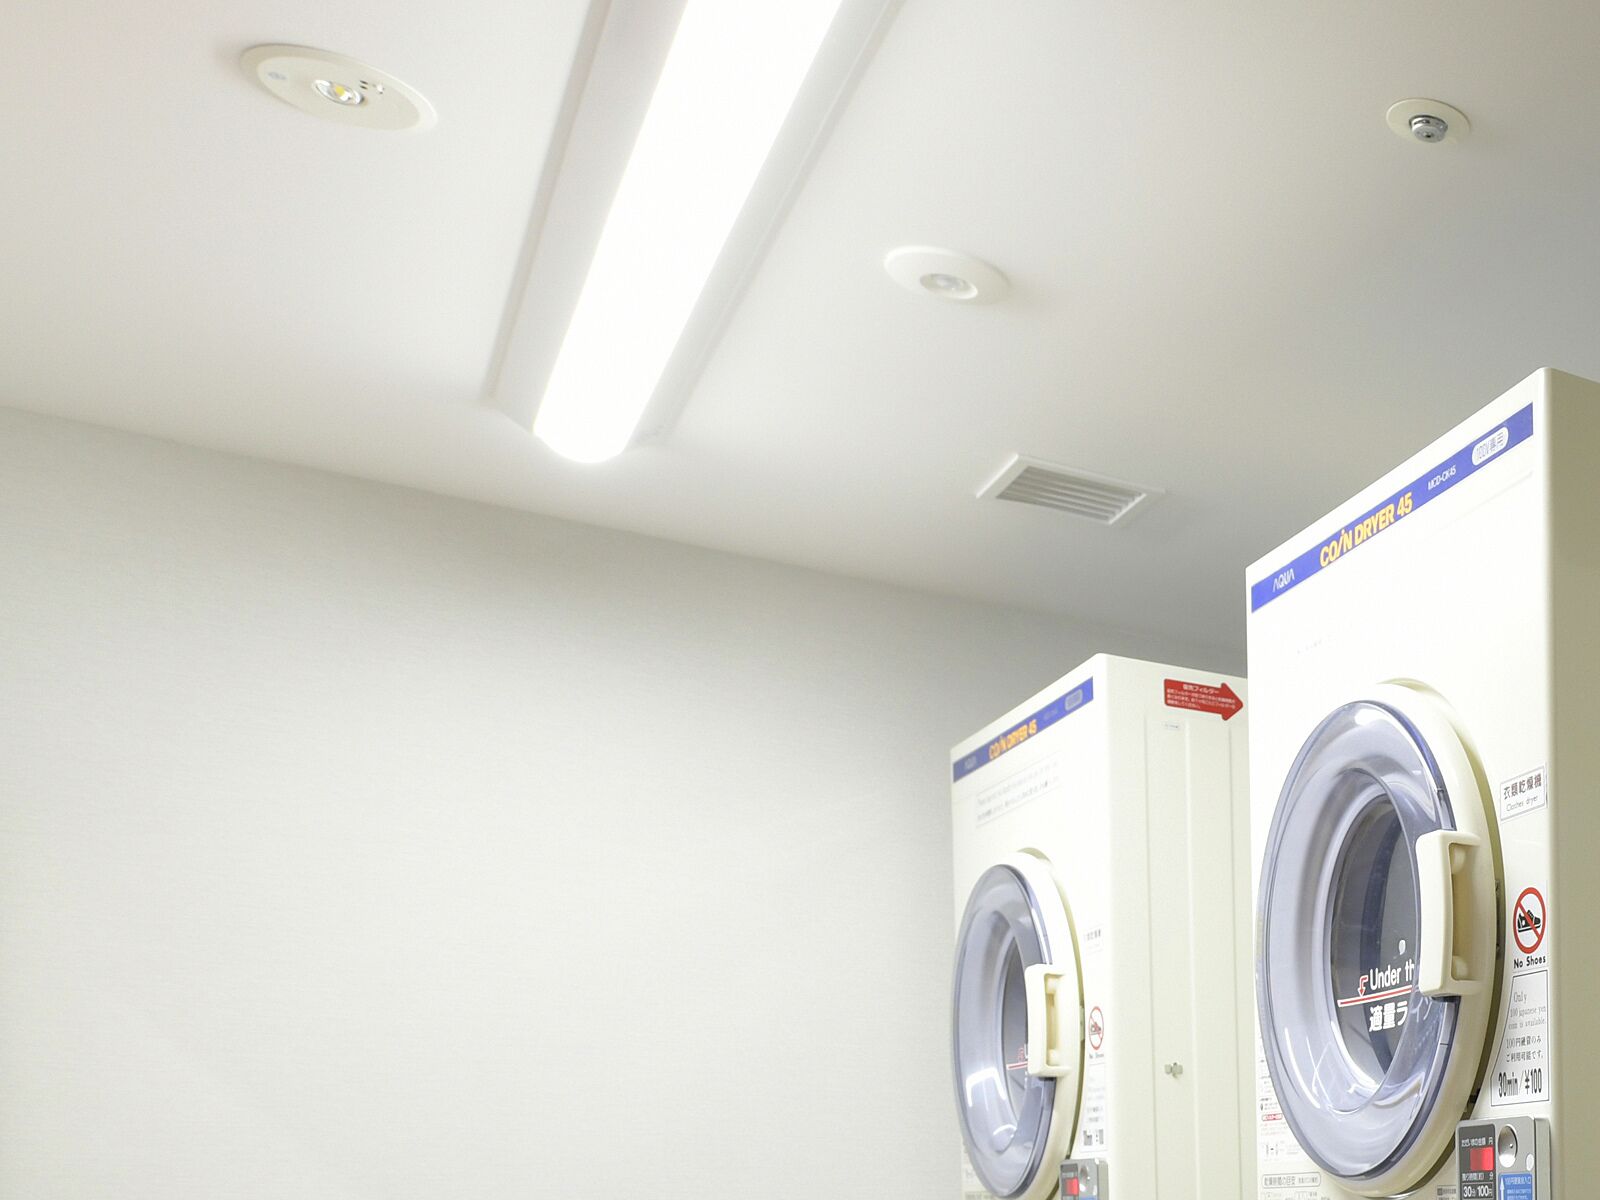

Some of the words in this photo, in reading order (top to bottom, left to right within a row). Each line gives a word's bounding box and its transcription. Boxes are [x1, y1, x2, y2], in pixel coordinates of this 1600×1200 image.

[1319, 526, 1353, 568] COIN
[1354, 503, 1395, 547] DRYER
[1396, 491, 1414, 517] 45
[1272, 567, 1295, 592] AQUA
[1369, 966, 1402, 992] Under
[1404, 957, 1415, 981] th
[1513, 959, 1524, 969] No
[1526, 955, 1546, 967] Shoes
